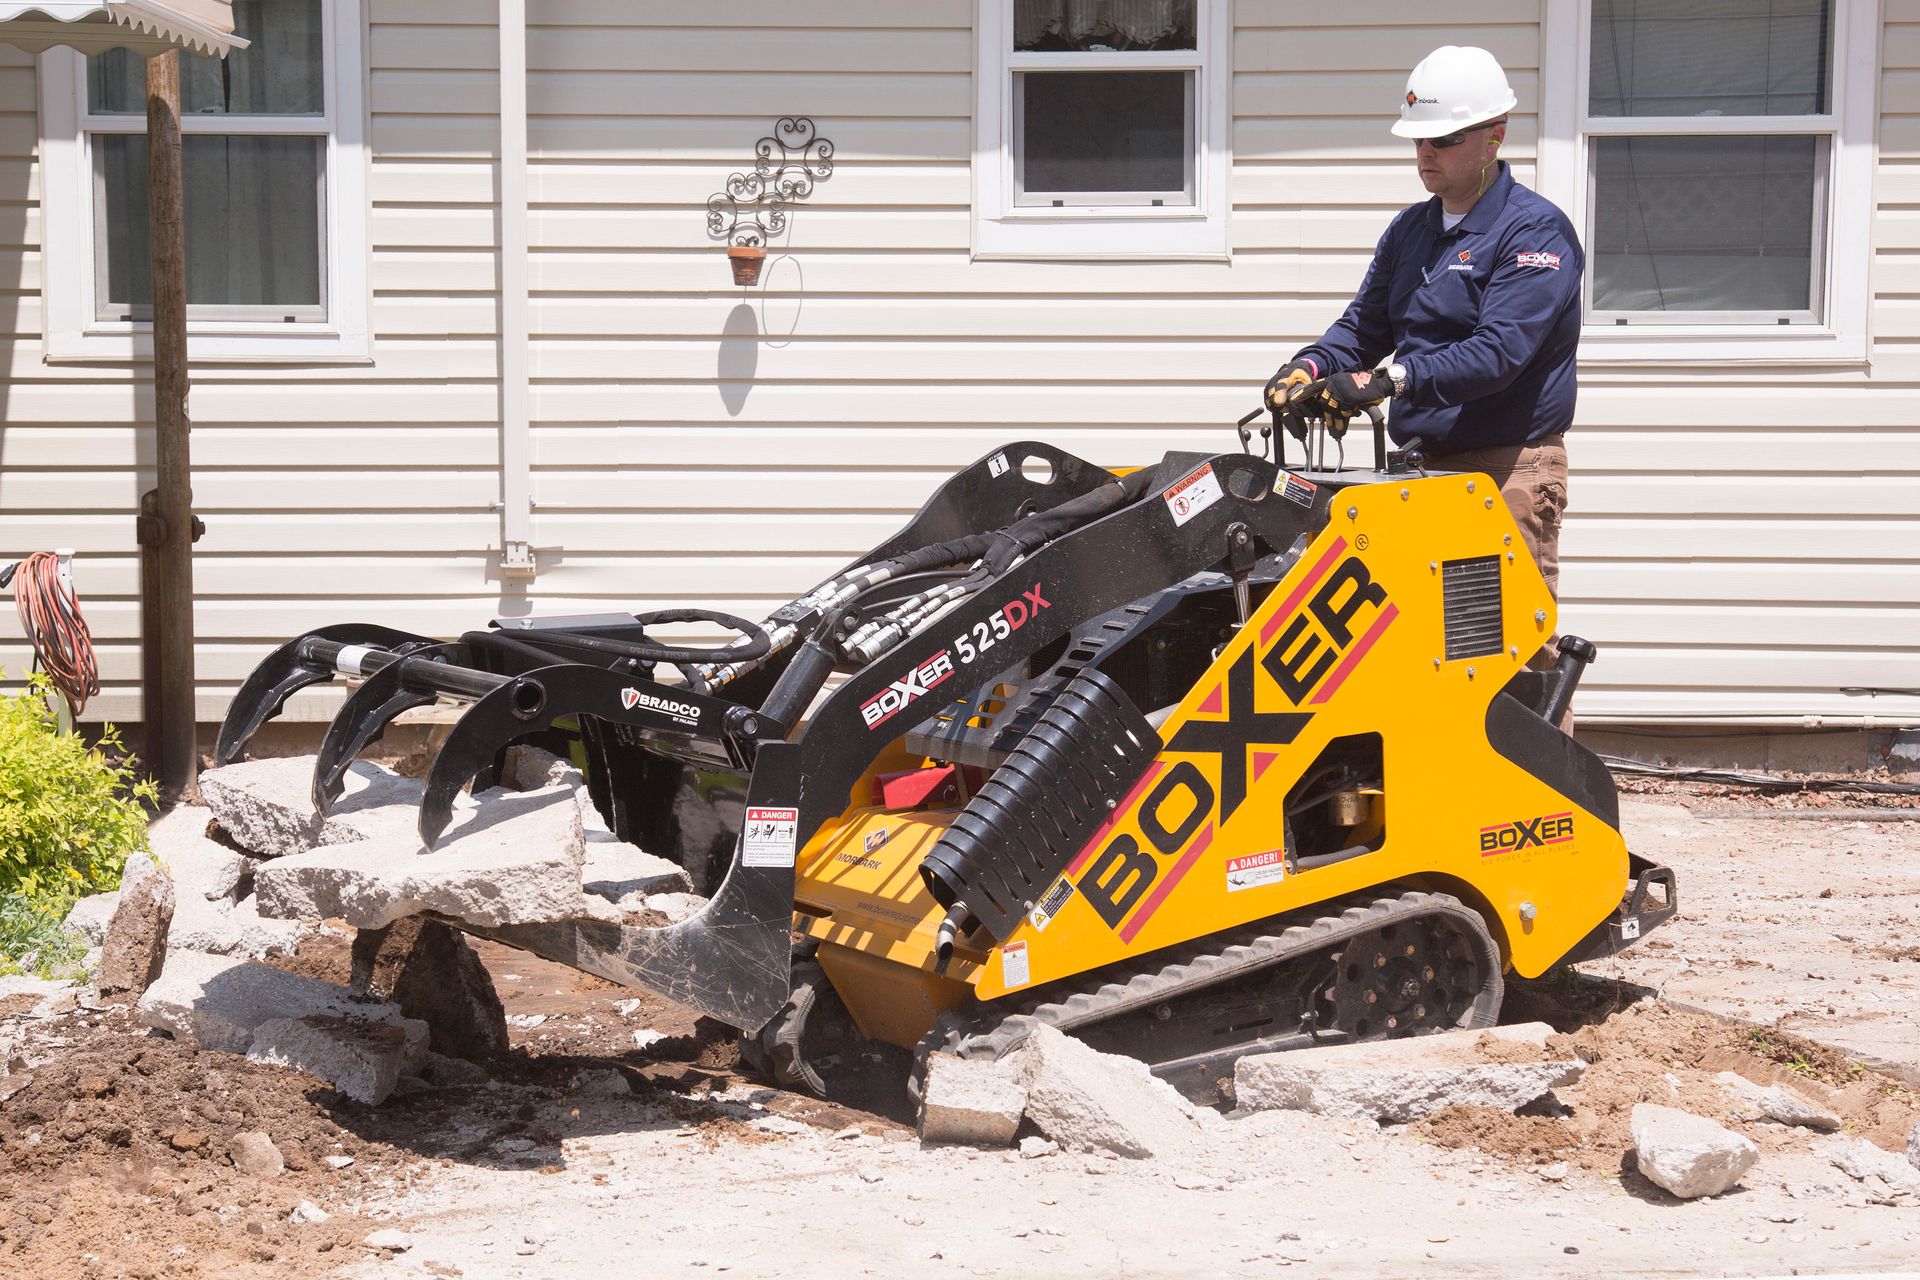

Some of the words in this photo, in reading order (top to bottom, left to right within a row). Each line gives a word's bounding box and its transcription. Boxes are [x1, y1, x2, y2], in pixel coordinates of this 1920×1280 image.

[1517, 252, 1560, 266] BOXER
[1175, 466, 1209, 492] WARNING
[861, 654, 953, 726] BOXER
[954, 582, 1052, 664] 525DX
[638, 694, 701, 717] BRADCO
[1076, 556, 1388, 930] BOXER
[761, 811, 793, 819] DANGER
[1480, 817, 1574, 851] BOXER
[835, 853, 882, 870] MORBARK
[1240, 852, 1278, 869] DANGER!
[1481, 858, 1493, 866] BIG
[1496, 853, 1521, 863] POWER
[1549, 843, 1575, 853] PLACES
